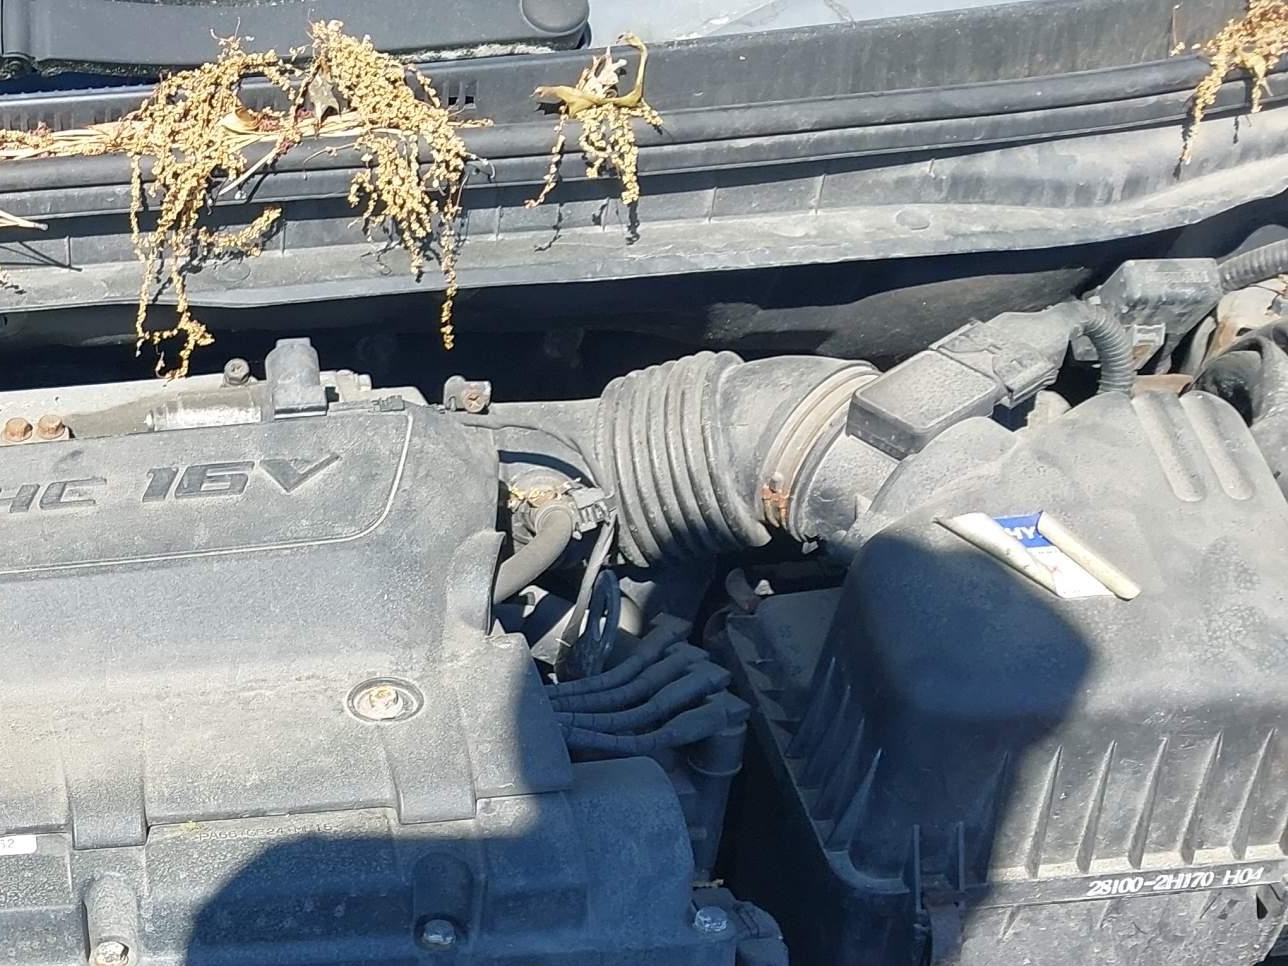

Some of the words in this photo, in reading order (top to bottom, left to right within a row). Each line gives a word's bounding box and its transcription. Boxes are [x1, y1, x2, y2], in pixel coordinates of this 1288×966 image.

[141, 452, 344, 503] 16V
[1086, 871, 1214, 896] 28100-2H170
[1222, 867, 1265, 885] H04
